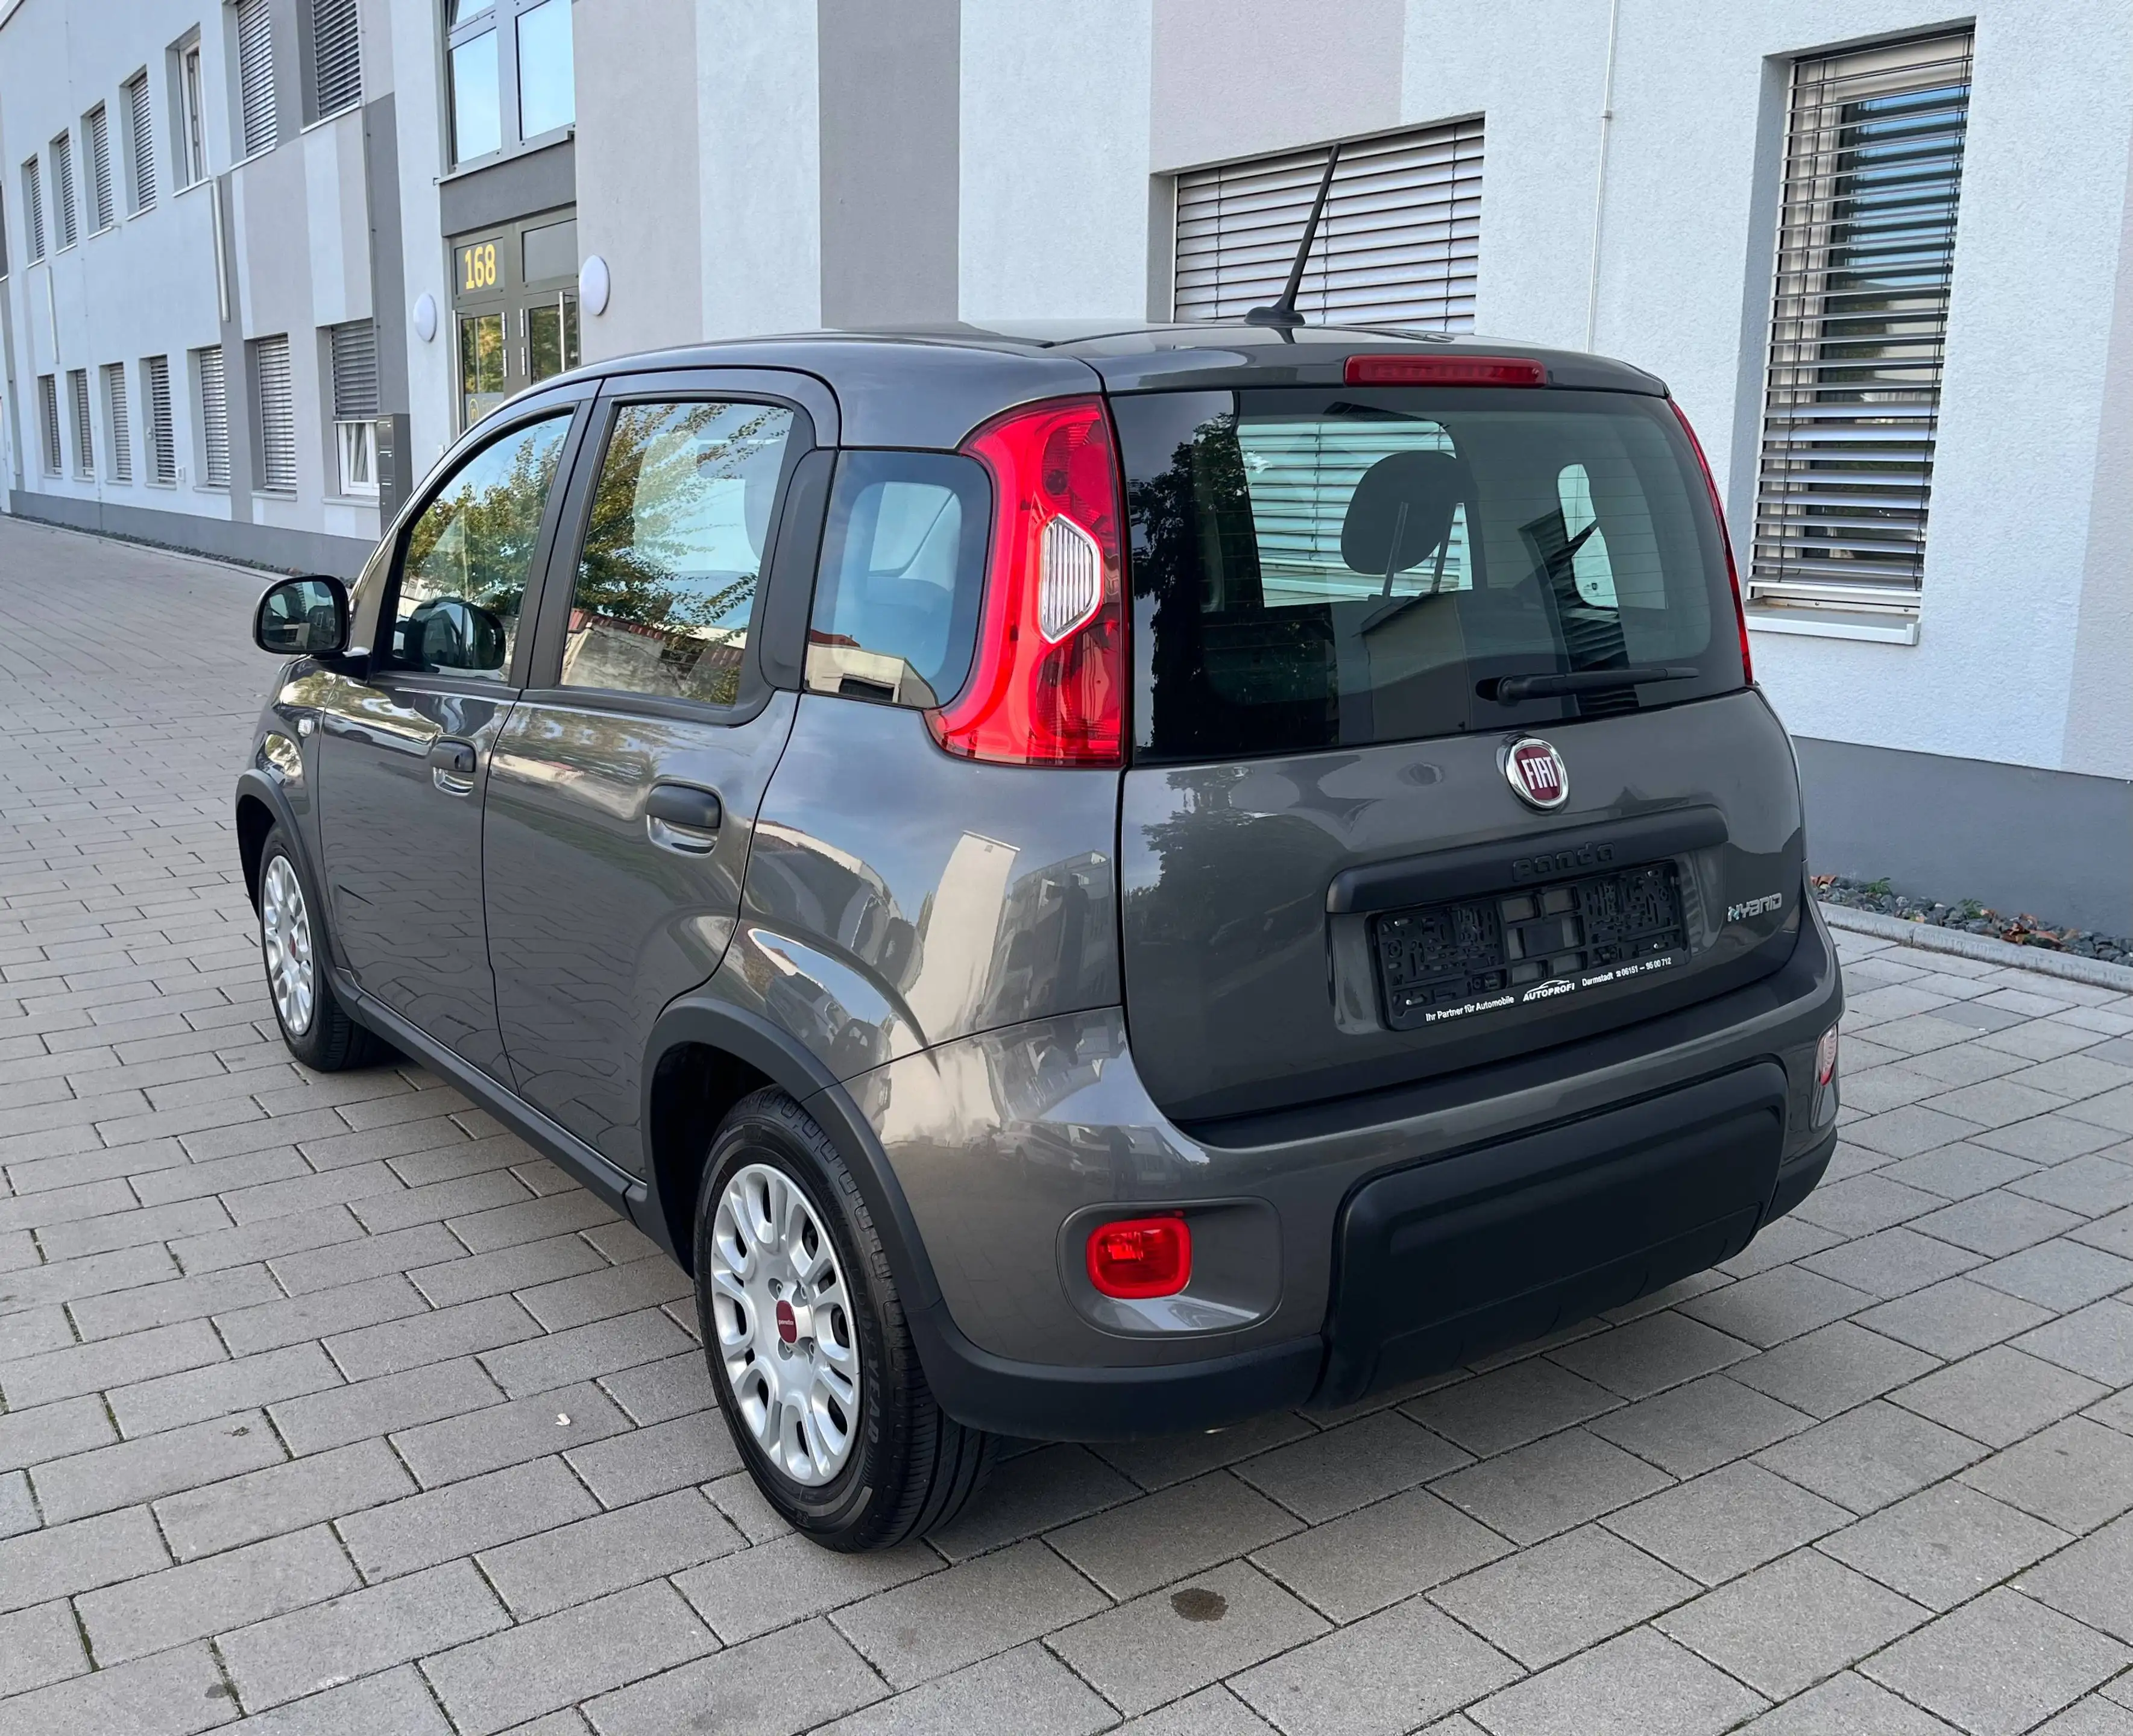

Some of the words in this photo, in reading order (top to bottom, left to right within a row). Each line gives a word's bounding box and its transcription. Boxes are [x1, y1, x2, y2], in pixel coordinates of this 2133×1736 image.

[465, 244, 496, 289] 168
[1521, 756, 1558, 790] FIAT
[1513, 841, 1615, 882] panda
[1727, 893, 1782, 922] HYBRID
[1426, 1013, 1436, 1021] Ihr
[1437, 1008, 1463, 1019] Partner
[1464, 1004, 1475, 1013] für
[1476, 995, 1514, 1011] Automobile
[1522, 983, 1575, 1002] AUTOPROFI
[1582, 972, 1613, 986] Darmstadt
[1621, 965, 1638, 976] 06151
